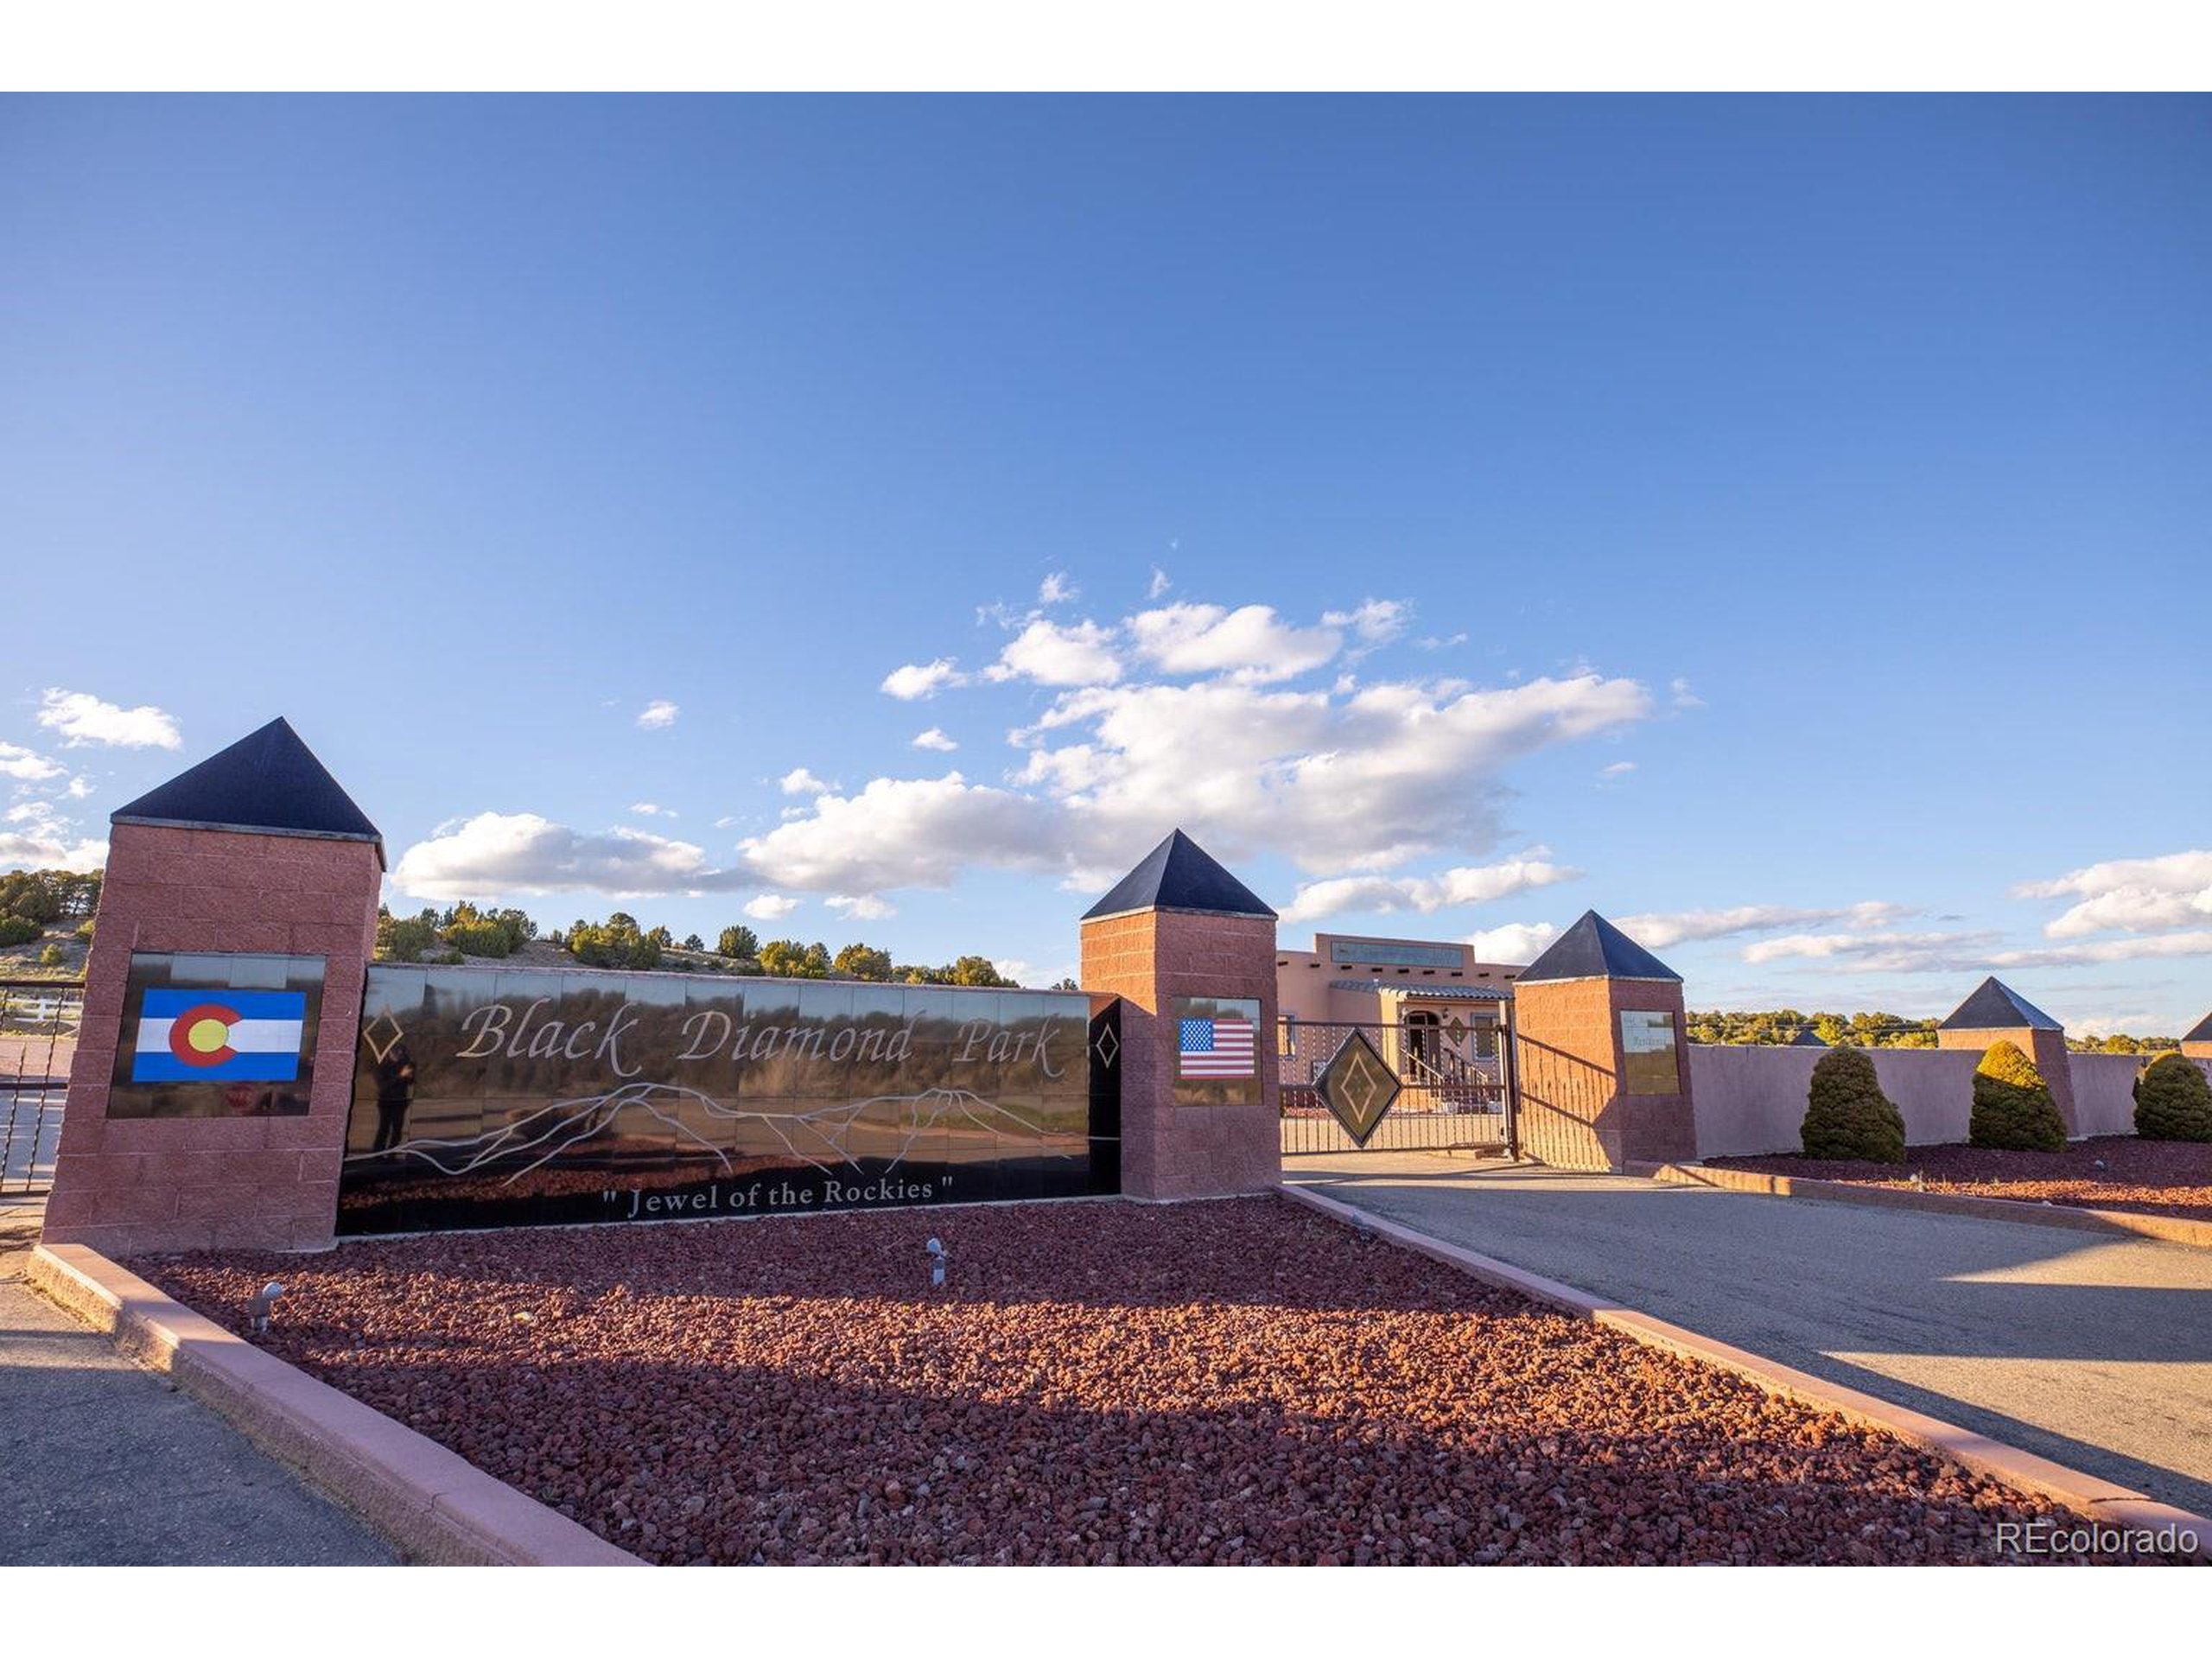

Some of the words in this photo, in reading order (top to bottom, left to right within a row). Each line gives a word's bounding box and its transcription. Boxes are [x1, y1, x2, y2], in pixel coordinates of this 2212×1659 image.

[455, 997, 642, 1077] Black
[677, 1008, 928, 1063] Diamond
[952, 1013, 1065, 1077] Park
[729, 1184, 761, 1207] of
[768, 1182, 813, 1205] the
